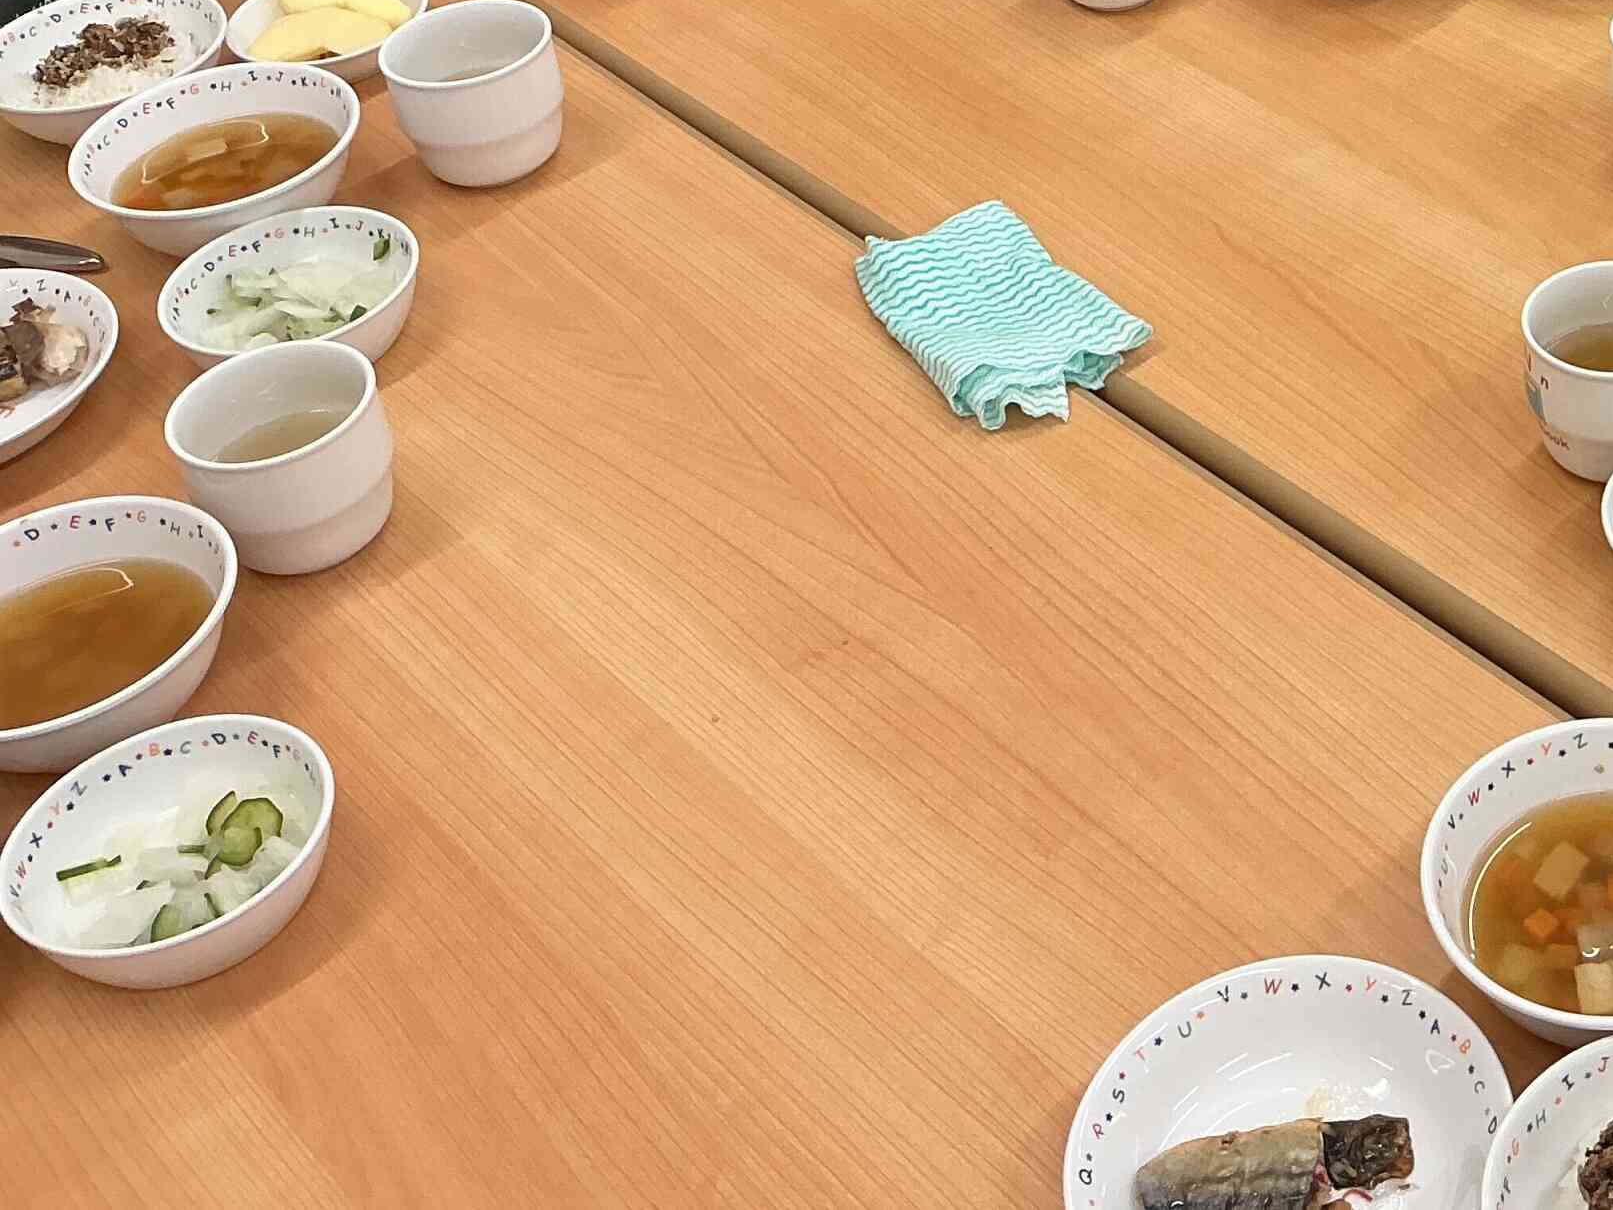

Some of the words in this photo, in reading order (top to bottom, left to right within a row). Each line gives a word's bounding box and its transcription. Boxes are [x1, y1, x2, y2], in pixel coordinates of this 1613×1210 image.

[24, 529, 39, 540] D
[70, 515, 81, 529] E
[211, 733, 226, 745] D
[1315, 972, 1331, 989] X
